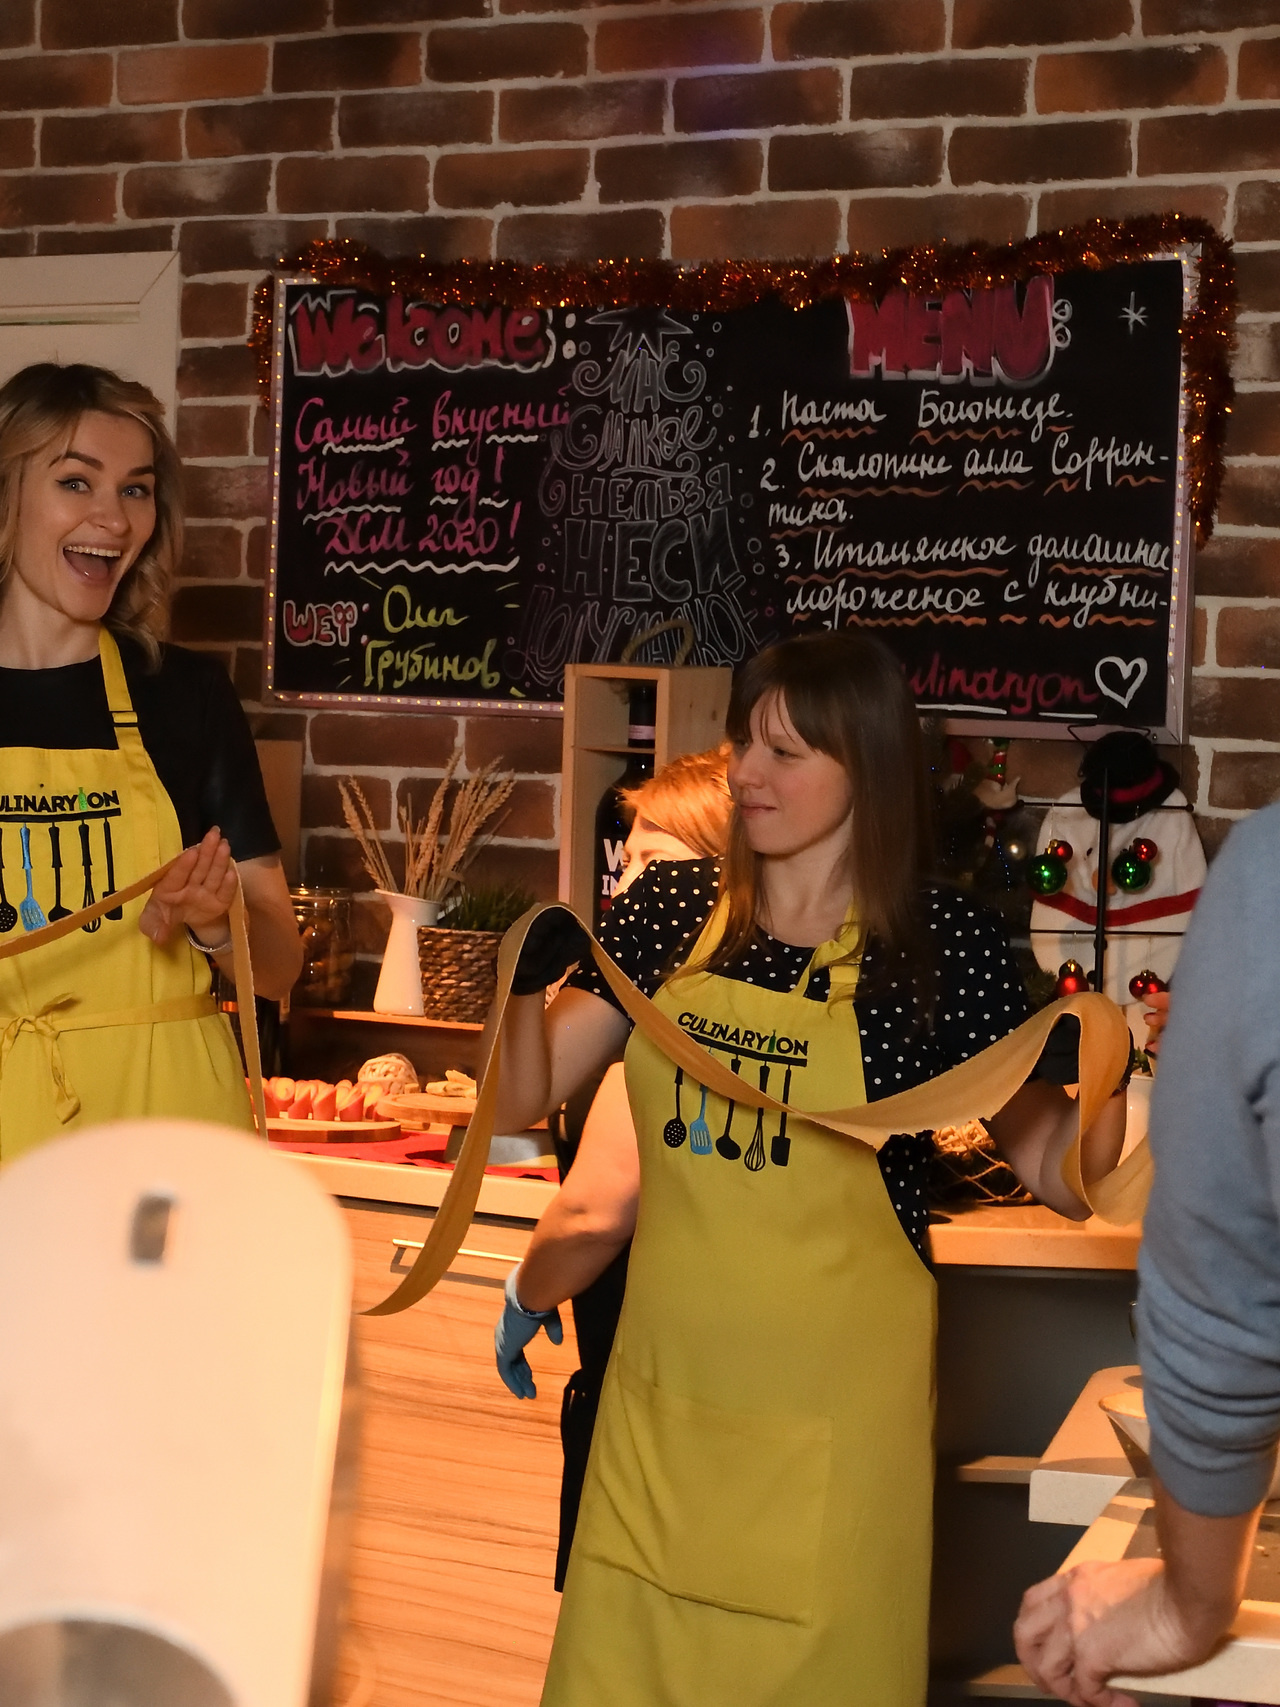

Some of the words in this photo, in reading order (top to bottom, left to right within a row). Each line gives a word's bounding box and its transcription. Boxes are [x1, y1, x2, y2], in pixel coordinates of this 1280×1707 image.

[295, 397, 417, 451] Самый
[432, 384, 571, 466] вкусный
[781, 390, 887, 430] Паста
[297, 449, 413, 510] Новый
[364, 638, 500, 691] Грубинов
[677, 1011, 809, 1056] CULINARYON
